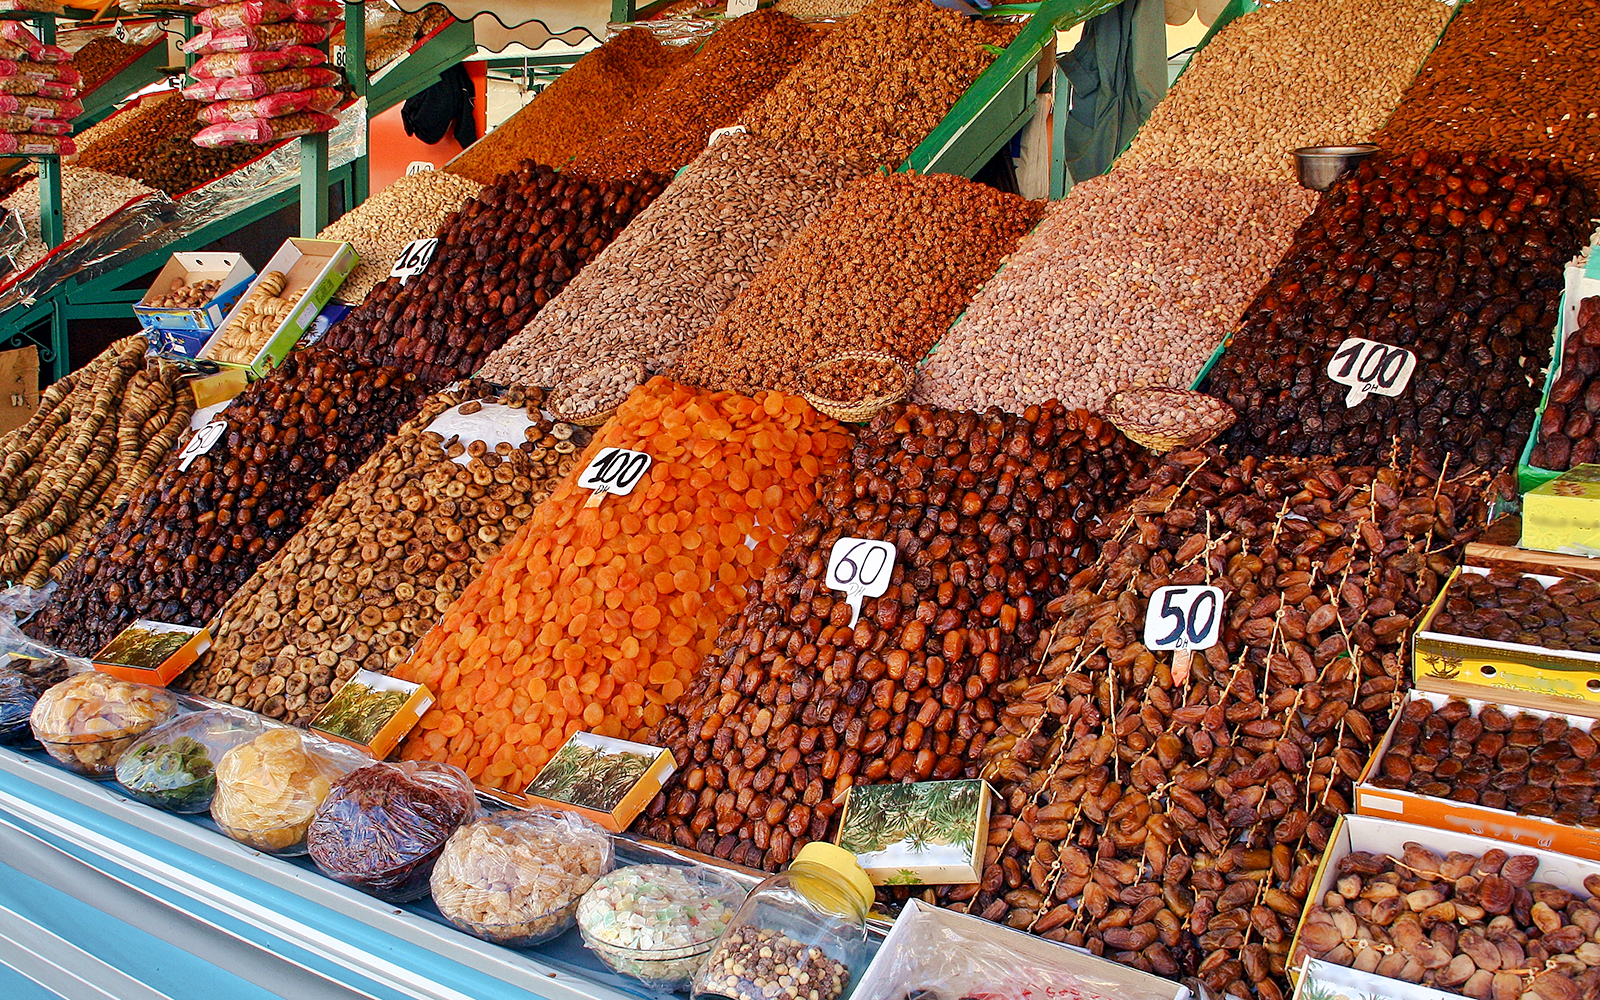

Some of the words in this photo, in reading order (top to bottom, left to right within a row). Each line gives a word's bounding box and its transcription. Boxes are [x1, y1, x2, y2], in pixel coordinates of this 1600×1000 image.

[1333, 341, 1409, 389] 100
[1361, 383, 1379, 392] DH
[588, 448, 649, 488] 100
[834, 541, 888, 586] 60
[1155, 588, 1217, 645] 50
[1175, 637, 1189, 649] DH
